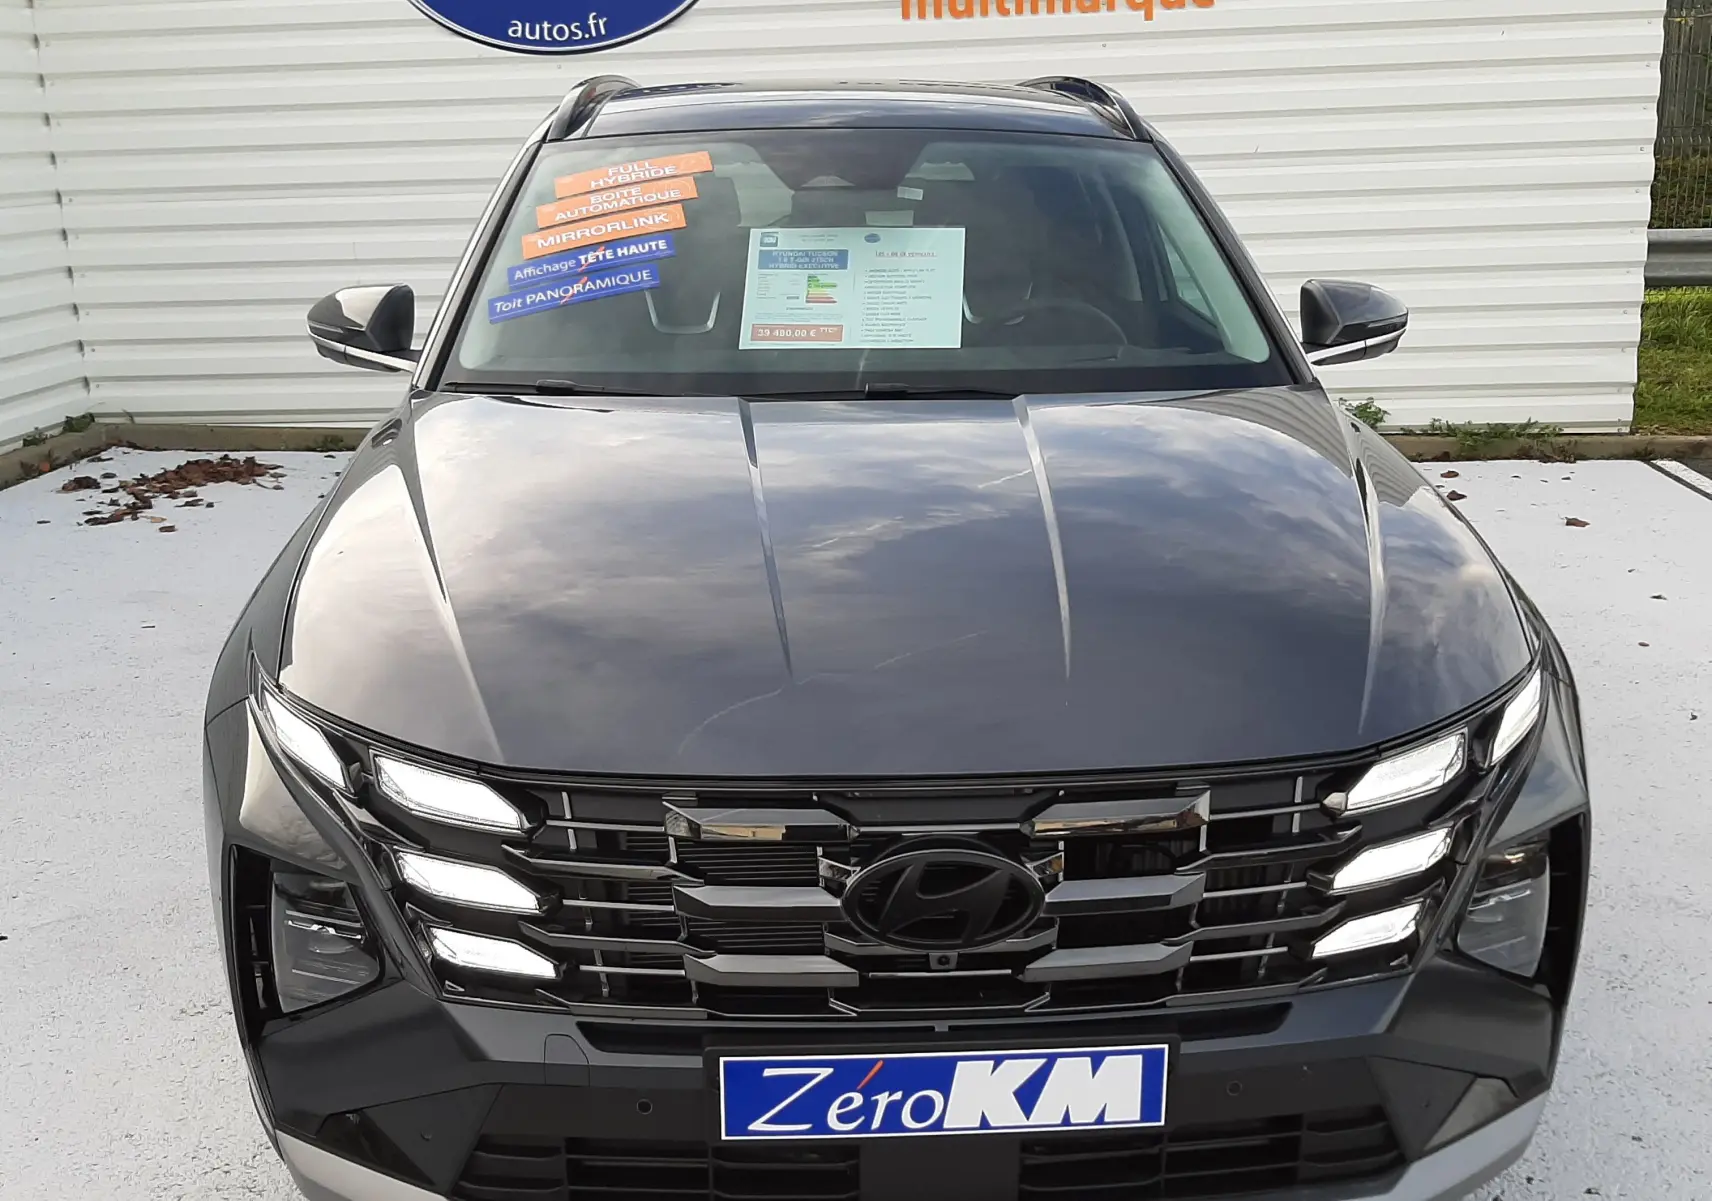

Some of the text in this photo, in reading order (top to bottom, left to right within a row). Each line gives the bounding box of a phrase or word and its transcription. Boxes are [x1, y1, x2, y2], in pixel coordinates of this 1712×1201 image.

[507, 12, 608, 41] autos.fr
[590, 165, 677, 189] HYBRIDE
[607, 161, 658, 176] FULL
[554, 189, 682, 221] AUTOMATIQUE
[590, 187, 642, 204] BOITE
[537, 212, 669, 249] MIRRORLINK
[514, 239, 668, 281] Affichage TÊTE HAUTE
[495, 269, 653, 313] Toit PANORAMIQUE
